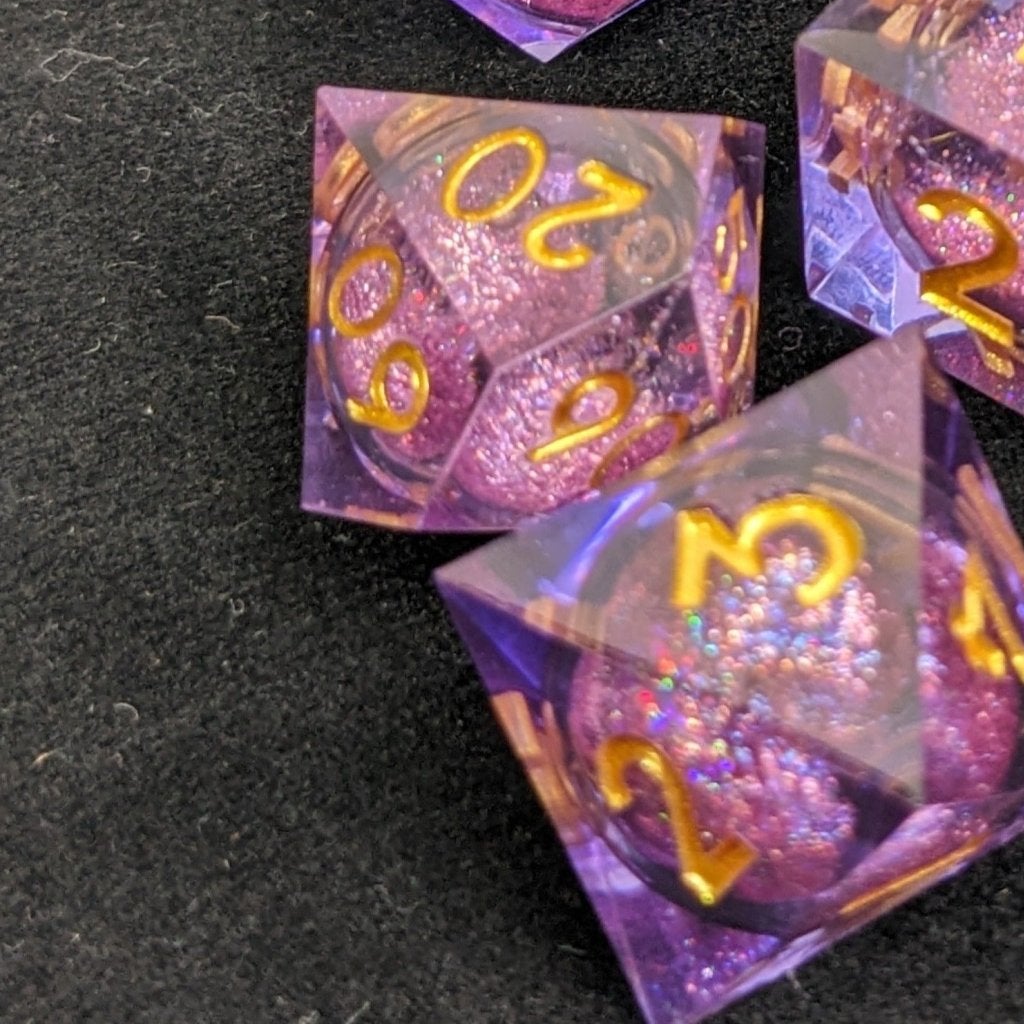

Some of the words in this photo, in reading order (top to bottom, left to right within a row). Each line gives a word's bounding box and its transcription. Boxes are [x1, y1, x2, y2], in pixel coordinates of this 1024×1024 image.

[442, 126, 651, 270] 20
[917, 187, 1019, 348] 2
[675, 494, 865, 610] 3
[602, 734, 758, 907] 2
